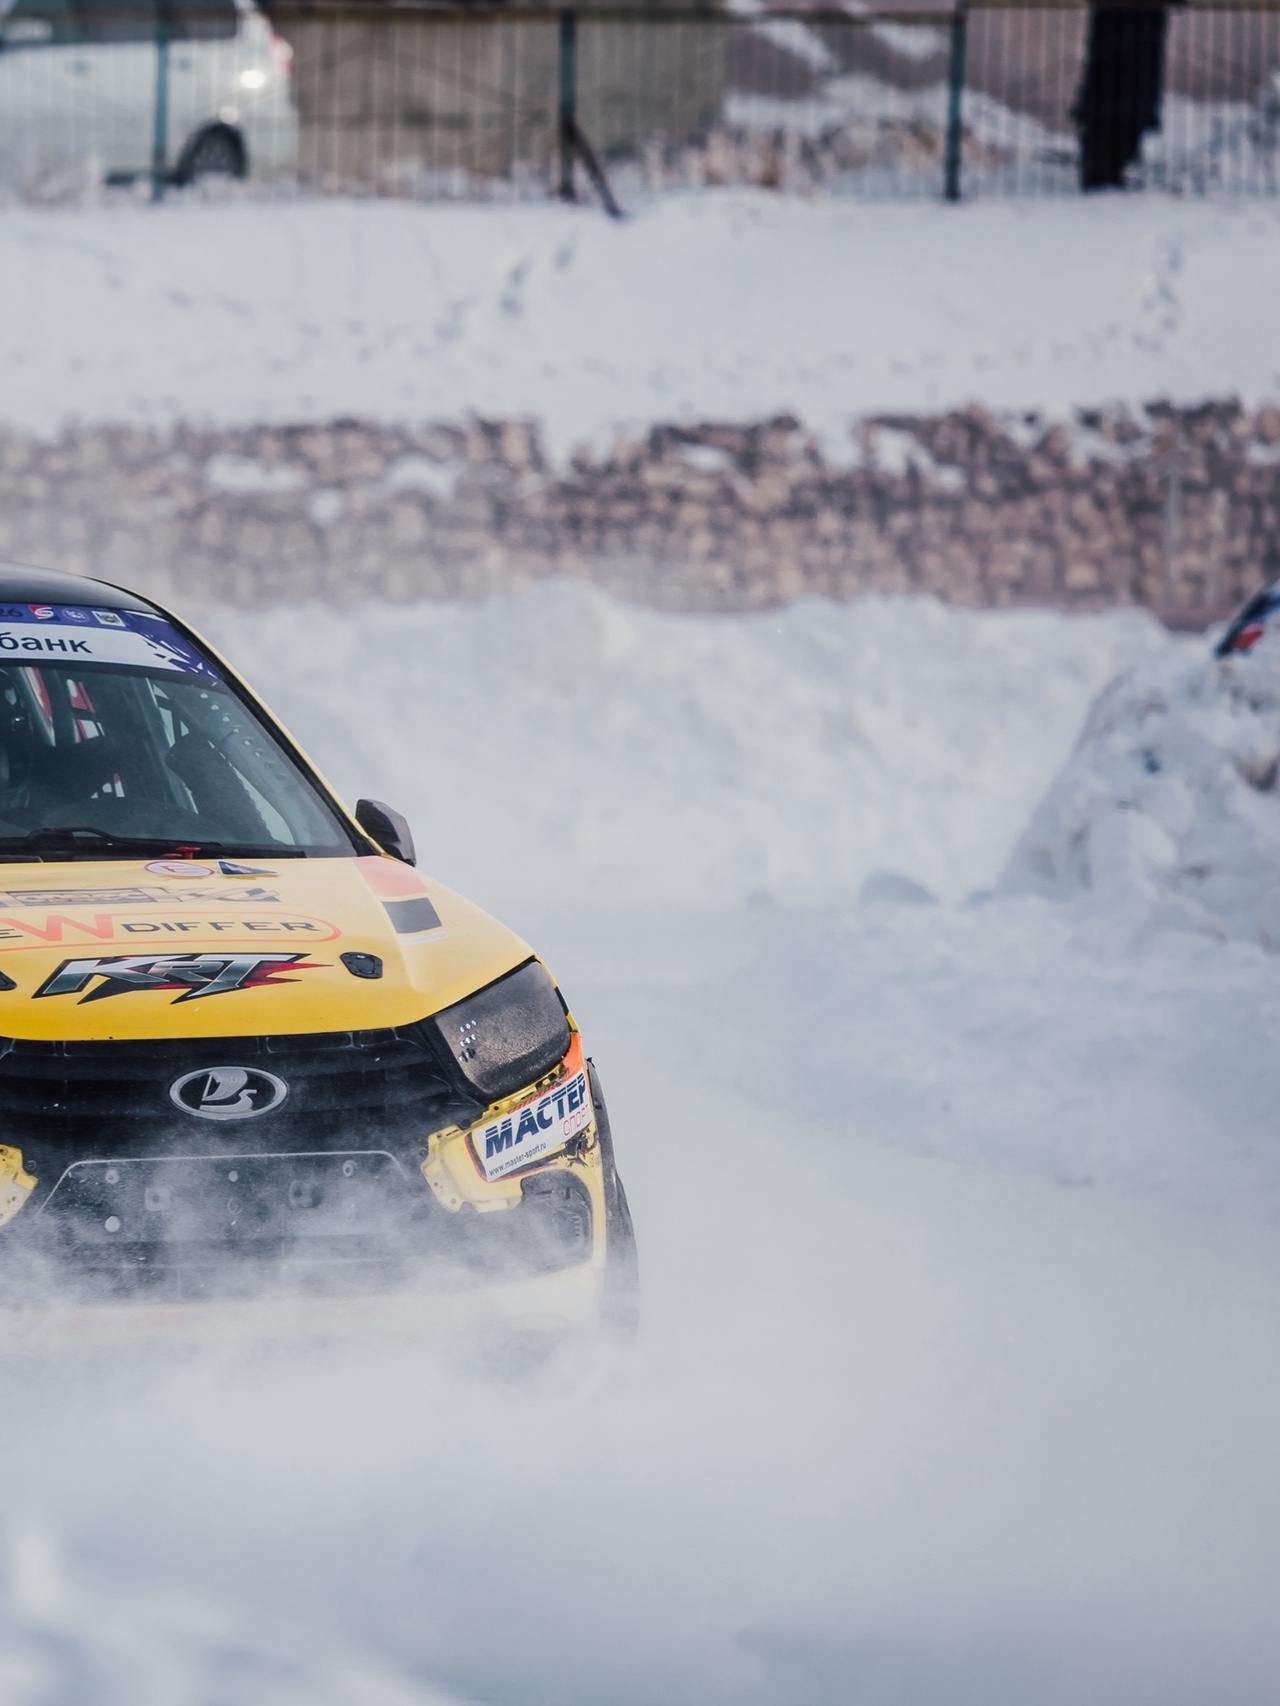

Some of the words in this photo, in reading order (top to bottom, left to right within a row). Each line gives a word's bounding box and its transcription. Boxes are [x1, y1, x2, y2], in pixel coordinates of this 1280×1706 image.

[485, 1073, 586, 1159] МАСТЕР
[562, 1103, 590, 1137] СПОРТ
[488, 1142, 548, 1177] www.master-sport.ru
